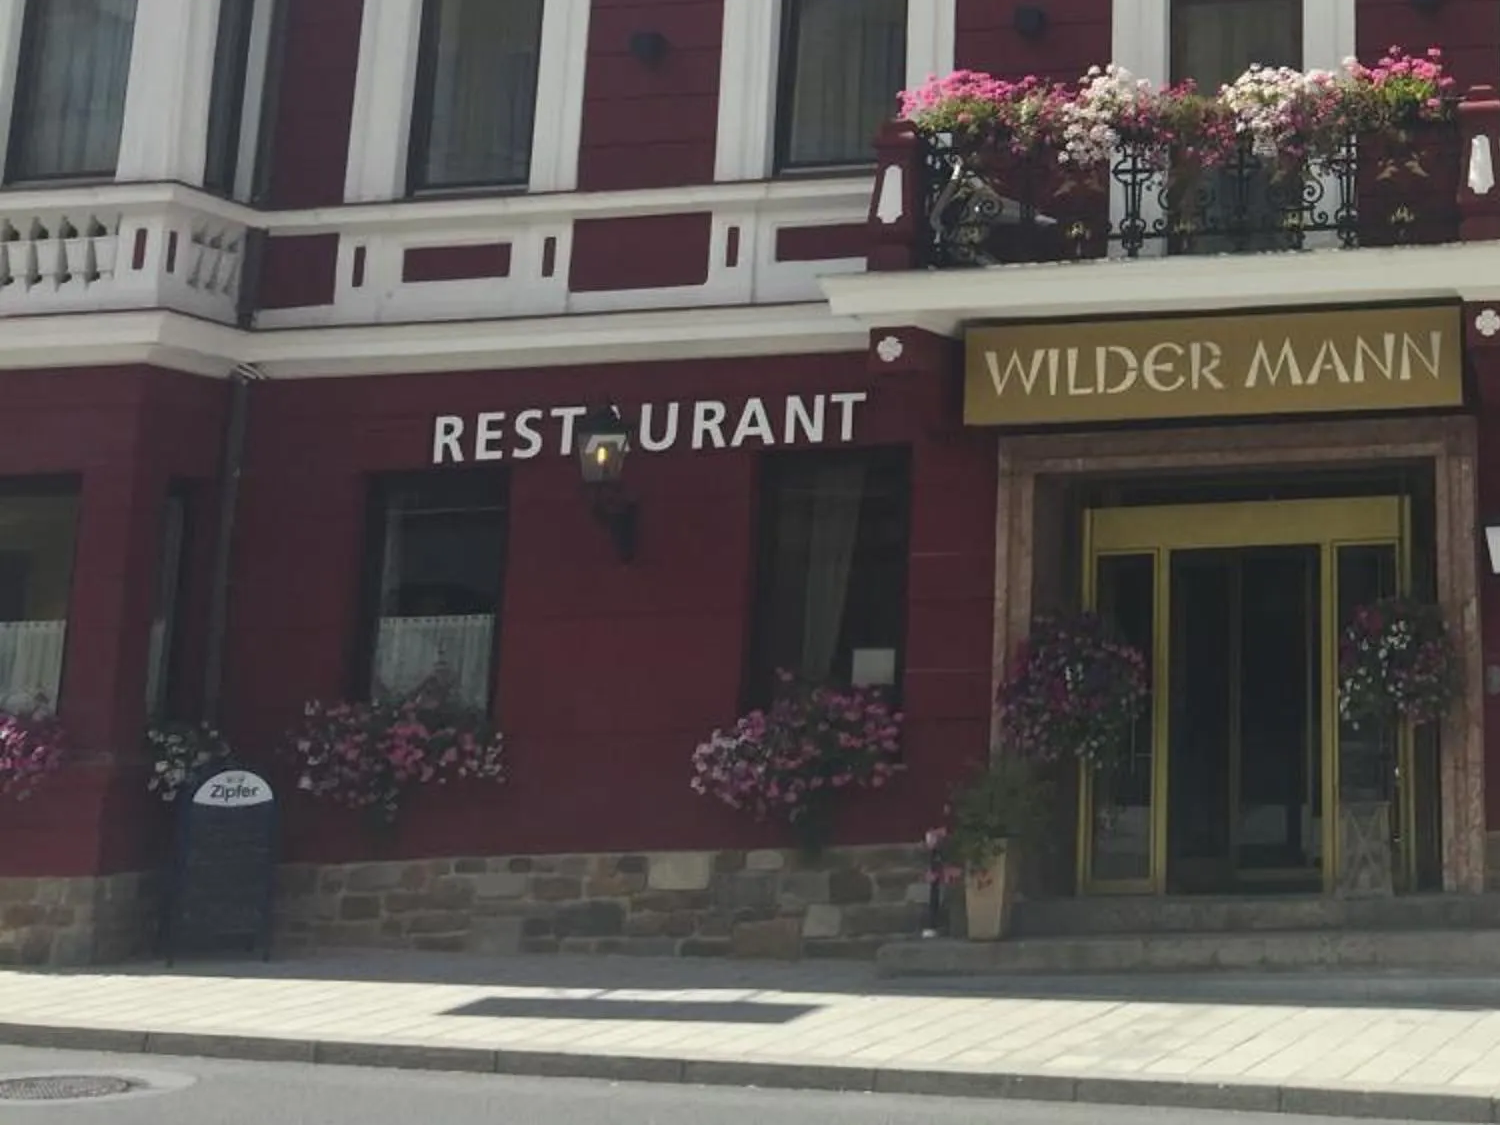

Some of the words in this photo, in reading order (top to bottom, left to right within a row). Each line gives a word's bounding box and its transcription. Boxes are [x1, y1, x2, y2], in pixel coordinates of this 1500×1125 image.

[985, 341, 1224, 395] WILDER
[1245, 331, 1442, 388] MANN
[210, 784, 260, 802] Zipfer
